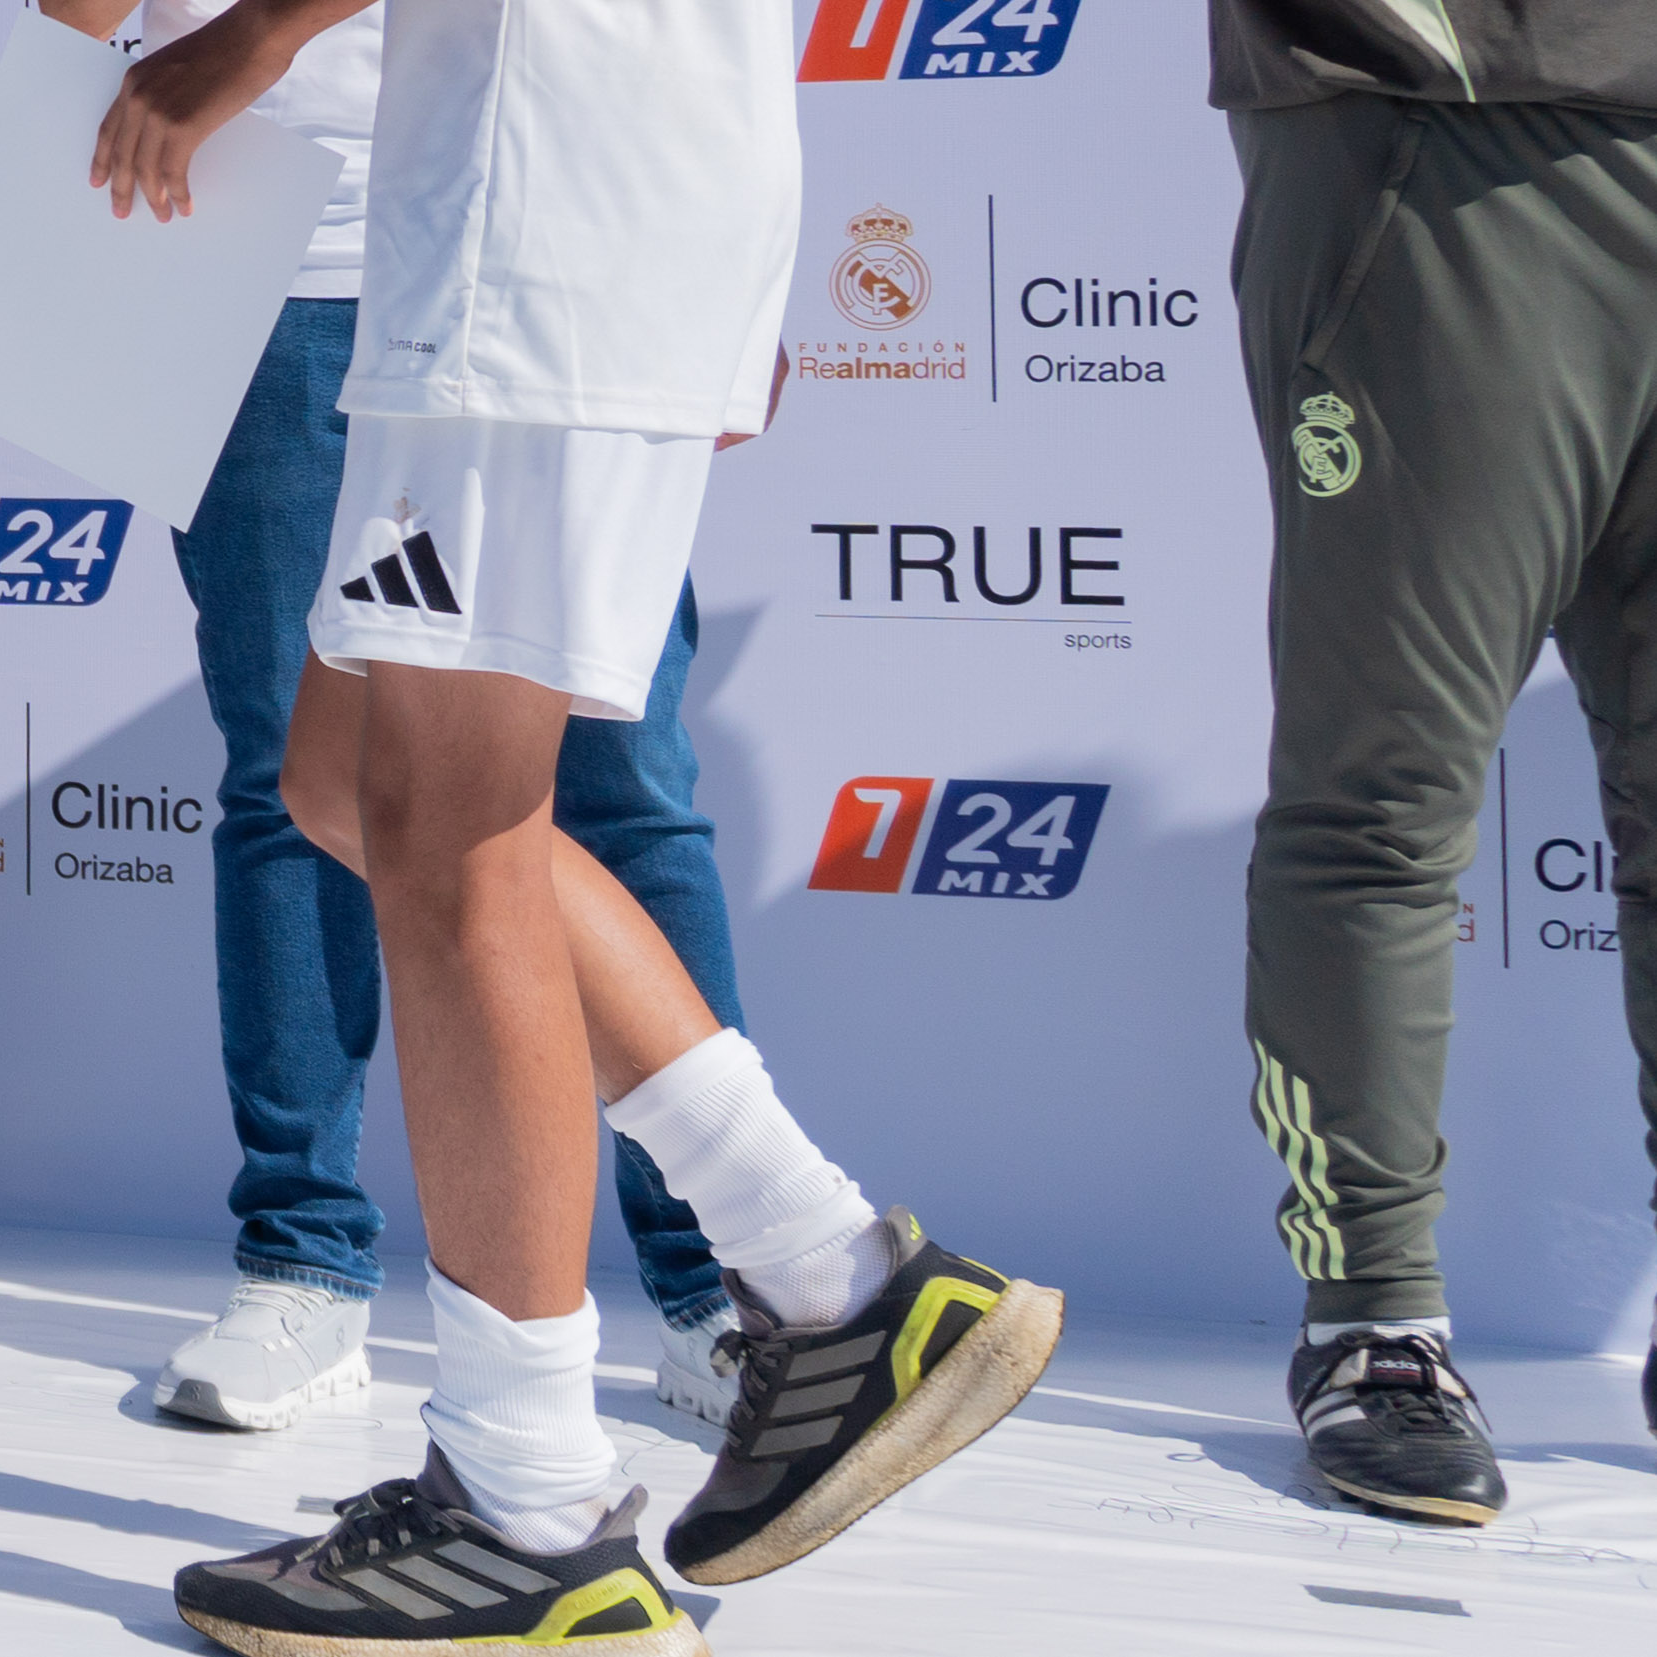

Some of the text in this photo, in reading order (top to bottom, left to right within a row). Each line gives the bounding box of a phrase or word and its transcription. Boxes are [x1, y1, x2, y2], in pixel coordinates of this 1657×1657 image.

[923, 51, 1040, 75] MIX
[1021, 278, 1198, 328] Clinic
[800, 339, 965, 354] FUNDACIÓN
[800, 357, 965, 379] Realmadrid
[1025, 355, 1165, 382] Orizaba
[811, 524, 1124, 606] TRUE
[1065, 634, 1132, 652] sports
[52, 781, 202, 833] Clinic
[945, 793, 1075, 865] 24
[55, 852, 174, 884] Orizaba
[937, 869, 1054, 896] MIX
[1540, 919, 1618, 952] Oriz
[1373, 1359, 1422, 1372] adida
